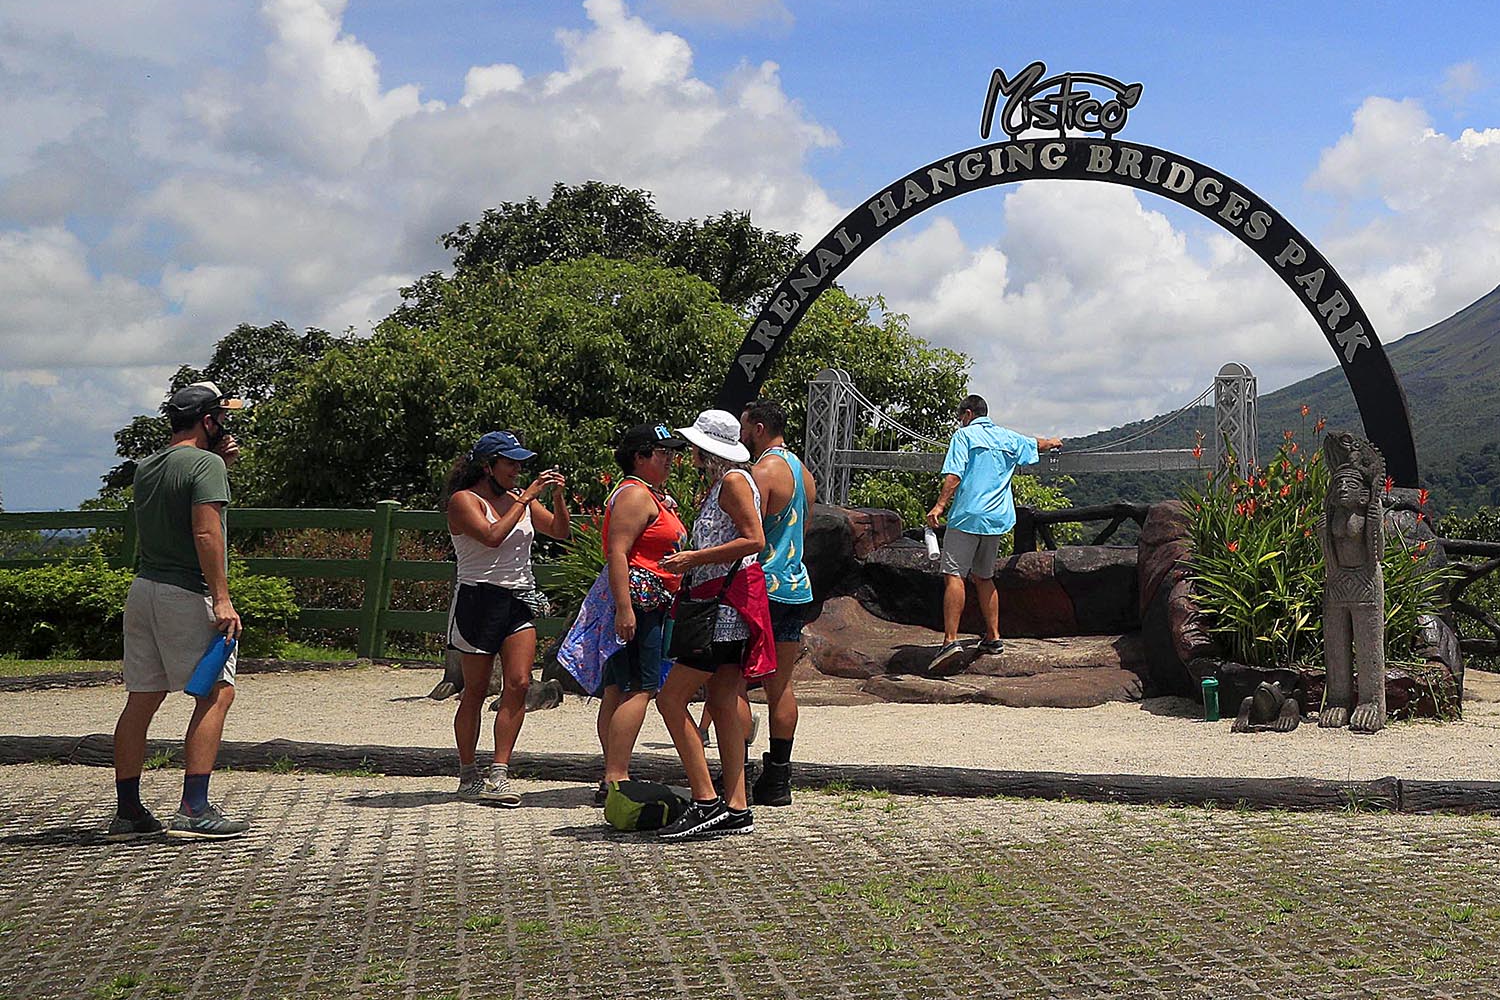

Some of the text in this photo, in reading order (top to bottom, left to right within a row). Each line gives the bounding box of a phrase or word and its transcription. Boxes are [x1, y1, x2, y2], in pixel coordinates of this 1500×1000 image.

[738, 143, 1371, 382] ARENAL HANGING BRIDGES PARK
